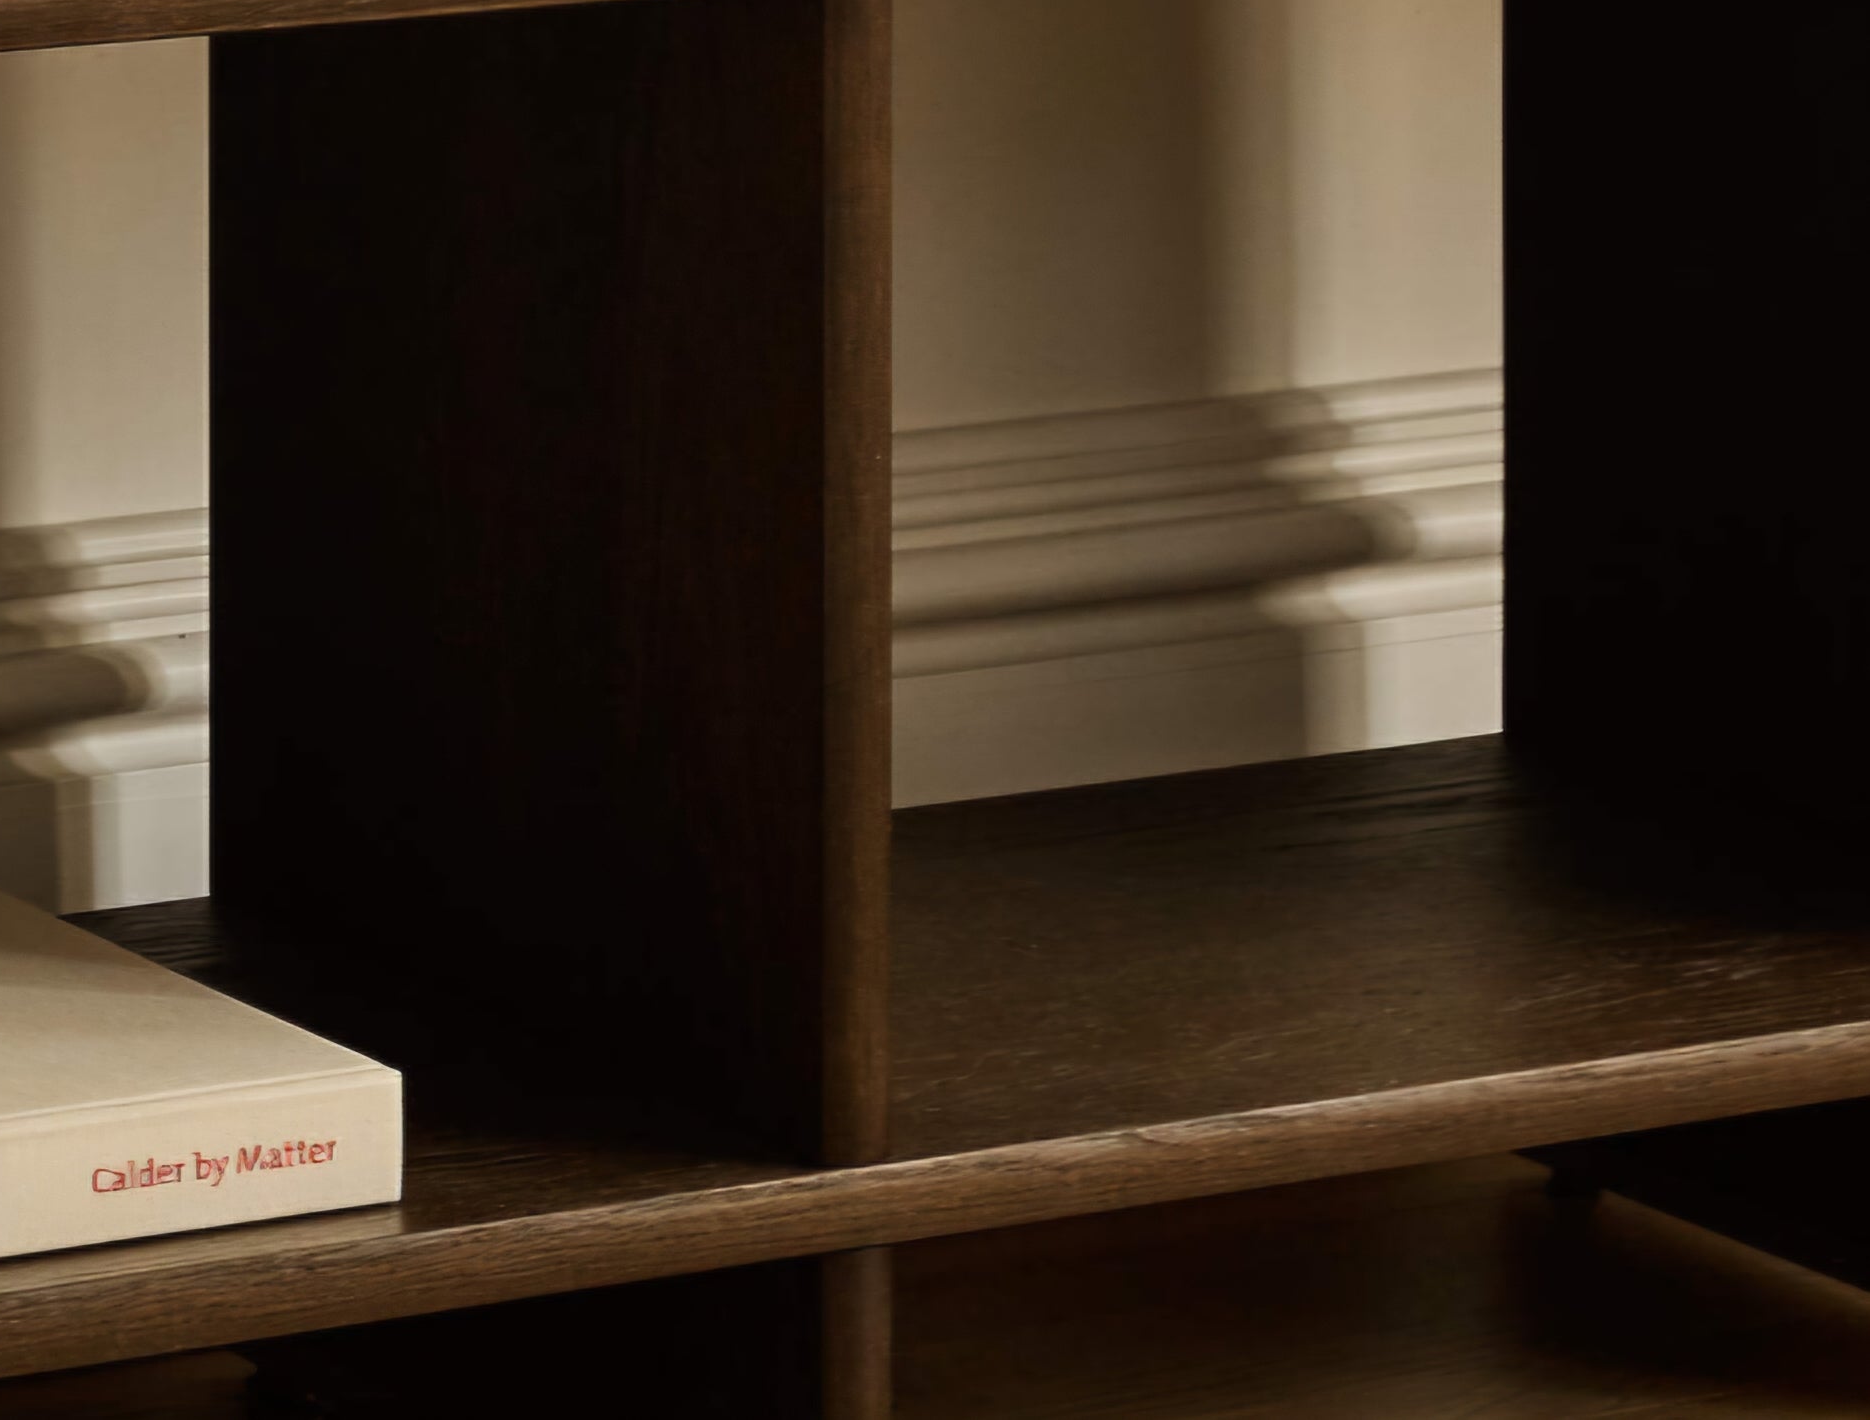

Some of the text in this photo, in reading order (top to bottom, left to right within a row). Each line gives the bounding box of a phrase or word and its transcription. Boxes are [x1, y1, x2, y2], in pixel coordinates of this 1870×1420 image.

[91, 1140, 337, 1193] Calder by Matter
